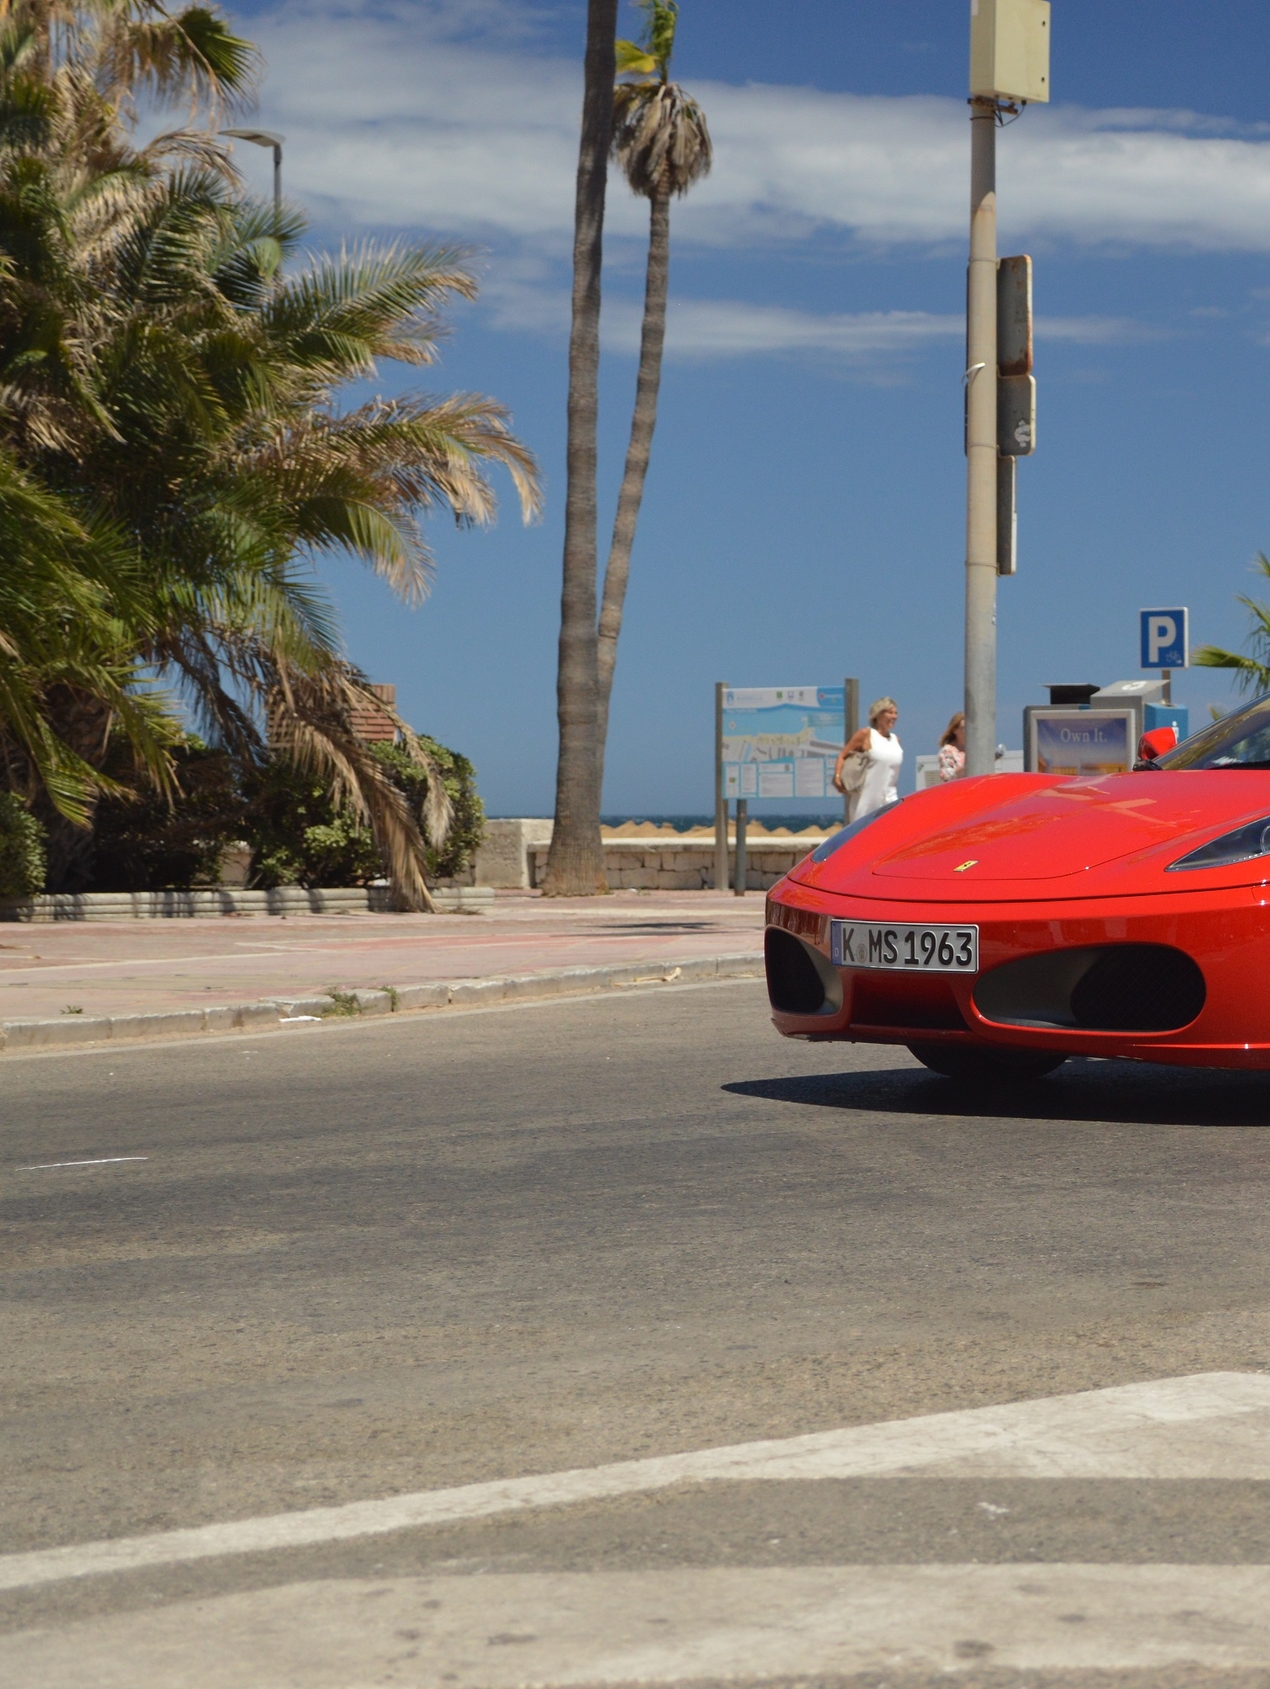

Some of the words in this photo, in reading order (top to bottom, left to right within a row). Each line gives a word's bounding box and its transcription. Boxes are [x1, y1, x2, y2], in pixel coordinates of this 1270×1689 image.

[1148, 616, 1176, 663] P
[1060, 728, 1090, 742] Own
[1094, 728, 1108, 742] It.
[842, 927, 855, 962] K
[868, 929, 899, 964] MS
[904, 931, 973, 966] 1963
